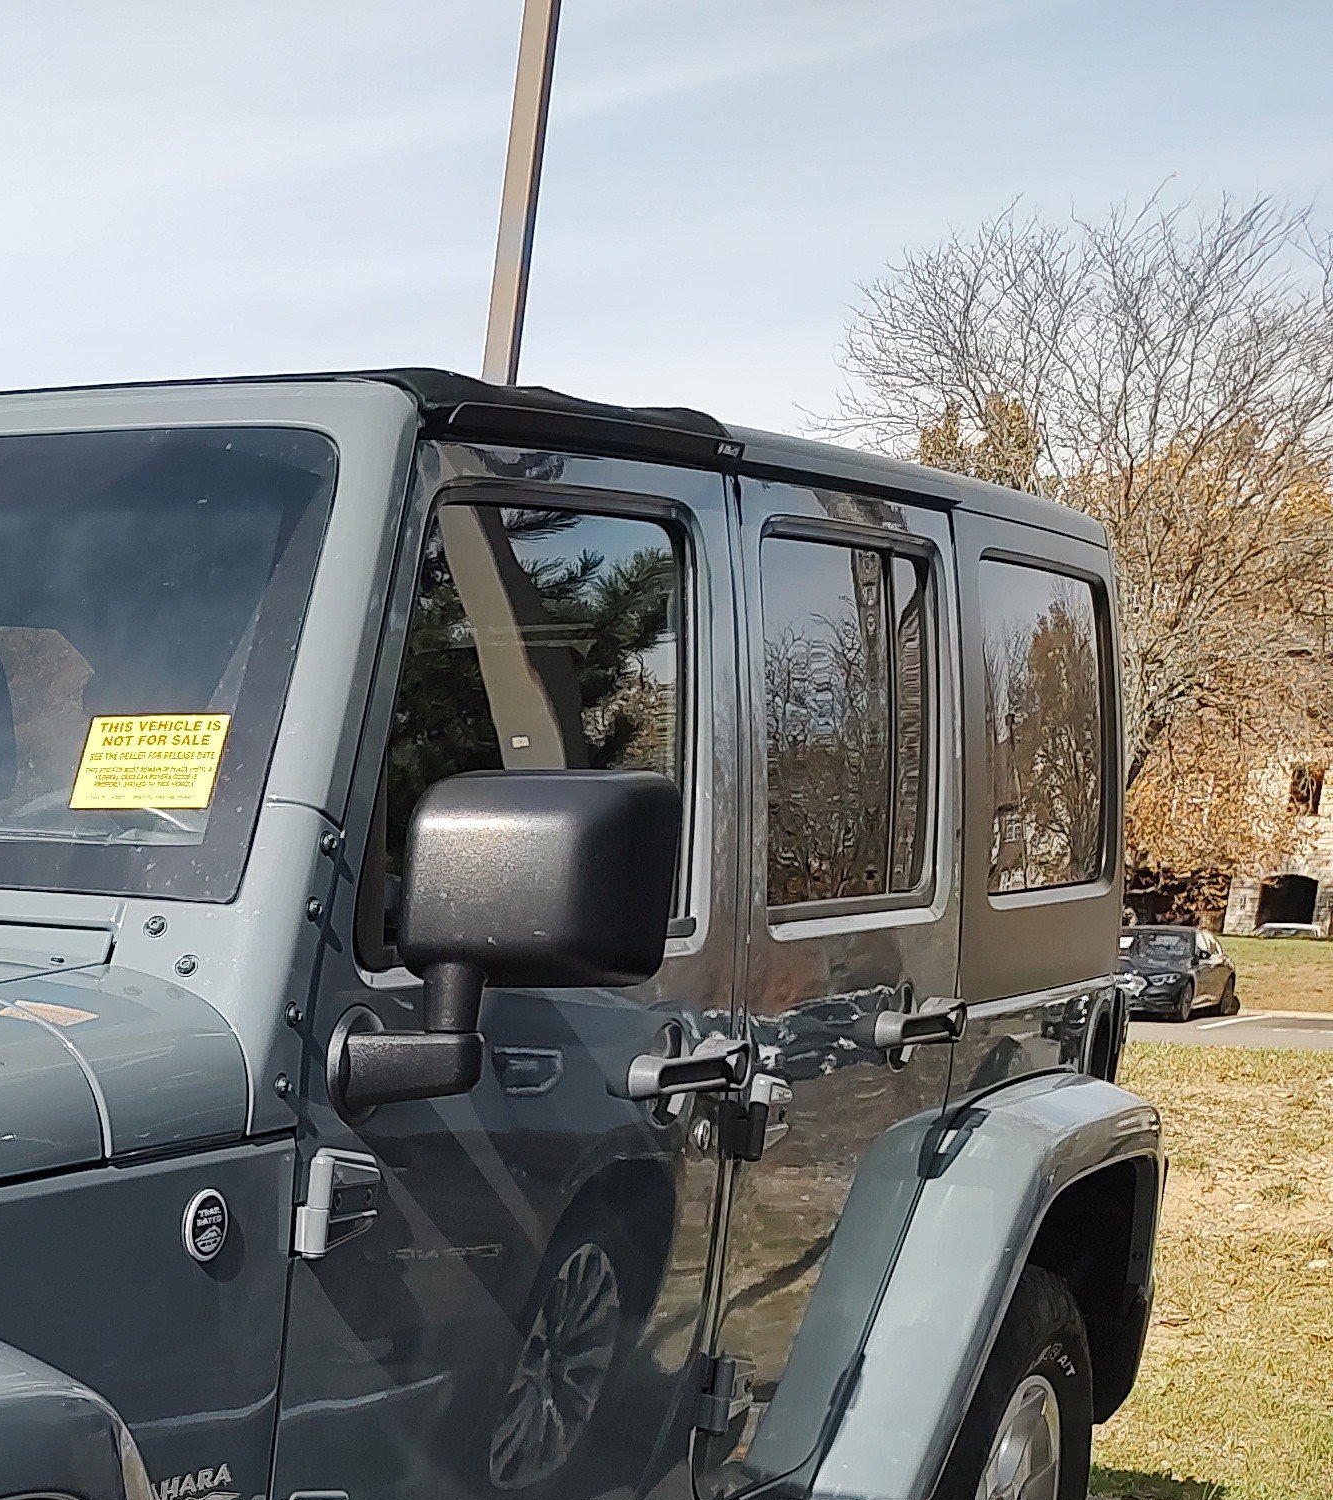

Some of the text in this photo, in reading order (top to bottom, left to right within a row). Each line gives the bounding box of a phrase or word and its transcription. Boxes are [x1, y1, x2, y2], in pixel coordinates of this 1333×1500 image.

[100, 720, 222, 733] THIS VEHICLE IS
[102, 734, 212, 747] NOT FOR SALE
